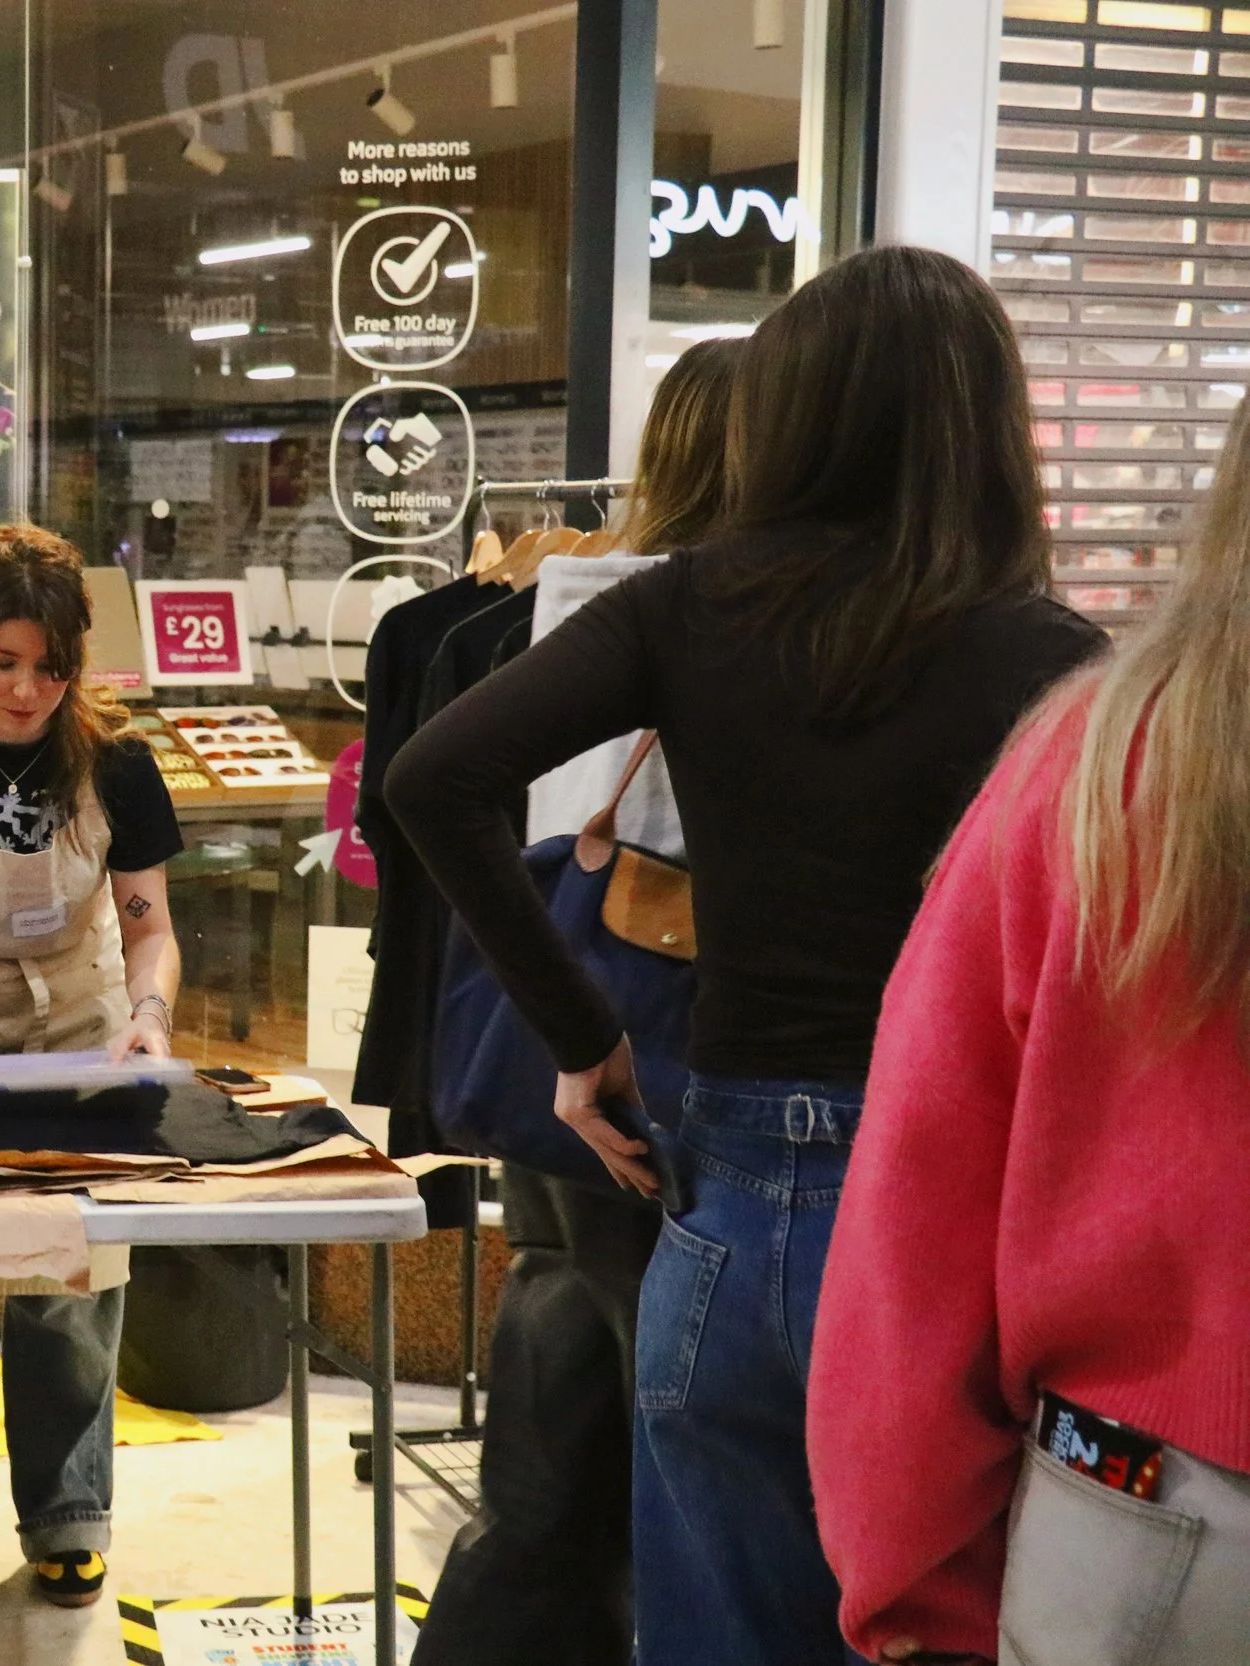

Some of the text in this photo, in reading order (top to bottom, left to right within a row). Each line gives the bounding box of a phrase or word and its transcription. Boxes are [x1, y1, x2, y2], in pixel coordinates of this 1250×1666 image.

[348, 140, 470, 160] More reasons
[340, 162, 477, 188] to shop with us
[354, 313, 456, 335] Free 100 day
[394, 335, 455, 350] guarantee
[353, 490, 452, 507] Free lifetime
[372, 508, 431, 525] servicing
[165, 614, 225, 650] £29
[200, 1616, 266, 1628] NIA
[222, 1624, 362, 1638] STUDIO
